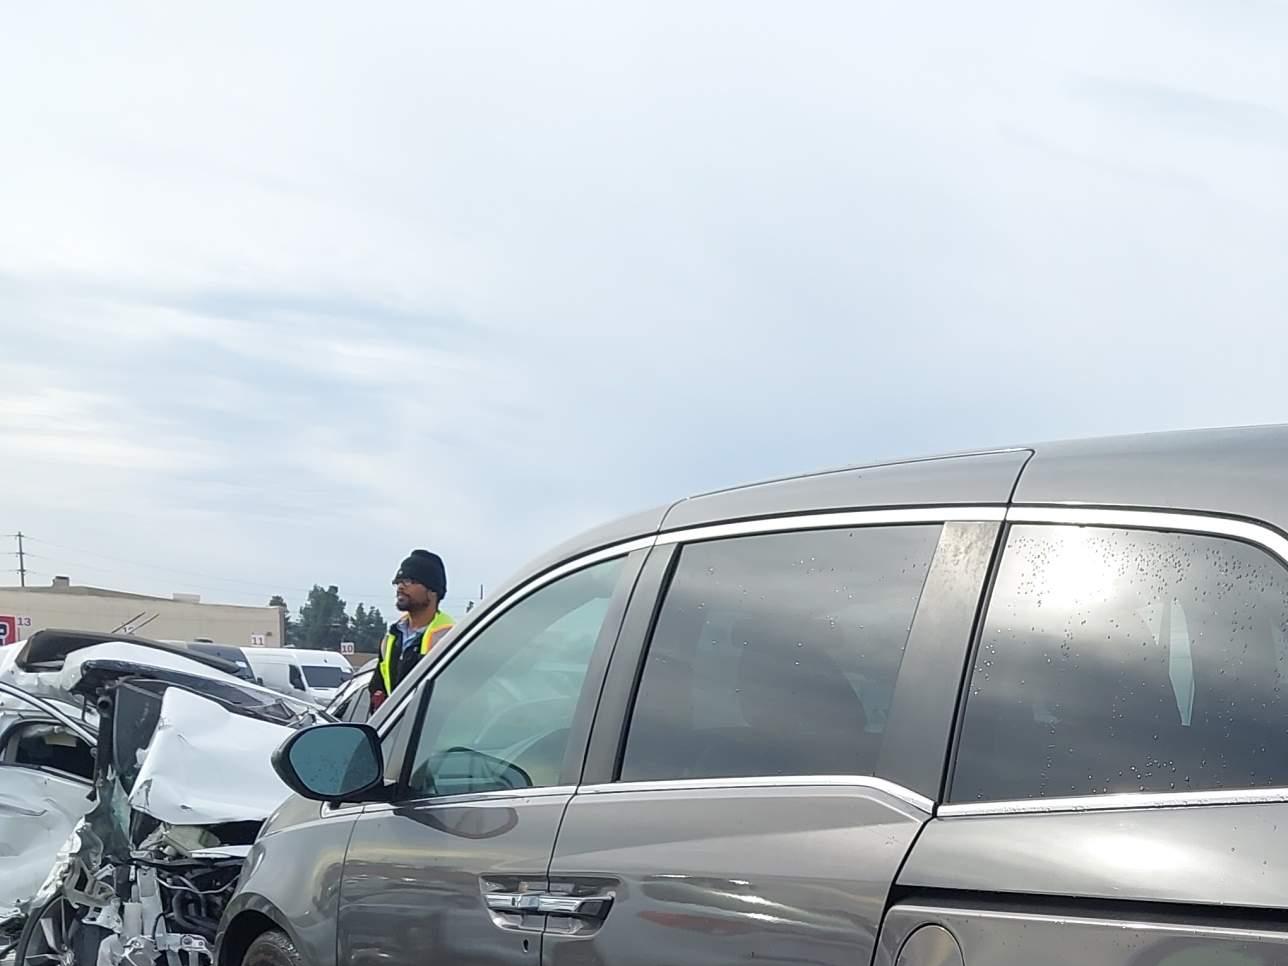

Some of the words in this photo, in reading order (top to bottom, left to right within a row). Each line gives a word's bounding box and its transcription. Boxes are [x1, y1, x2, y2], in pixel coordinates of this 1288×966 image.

[17, 617, 32, 627] 13
[252, 636, 264, 646] 11
[342, 644, 353, 653] 10
